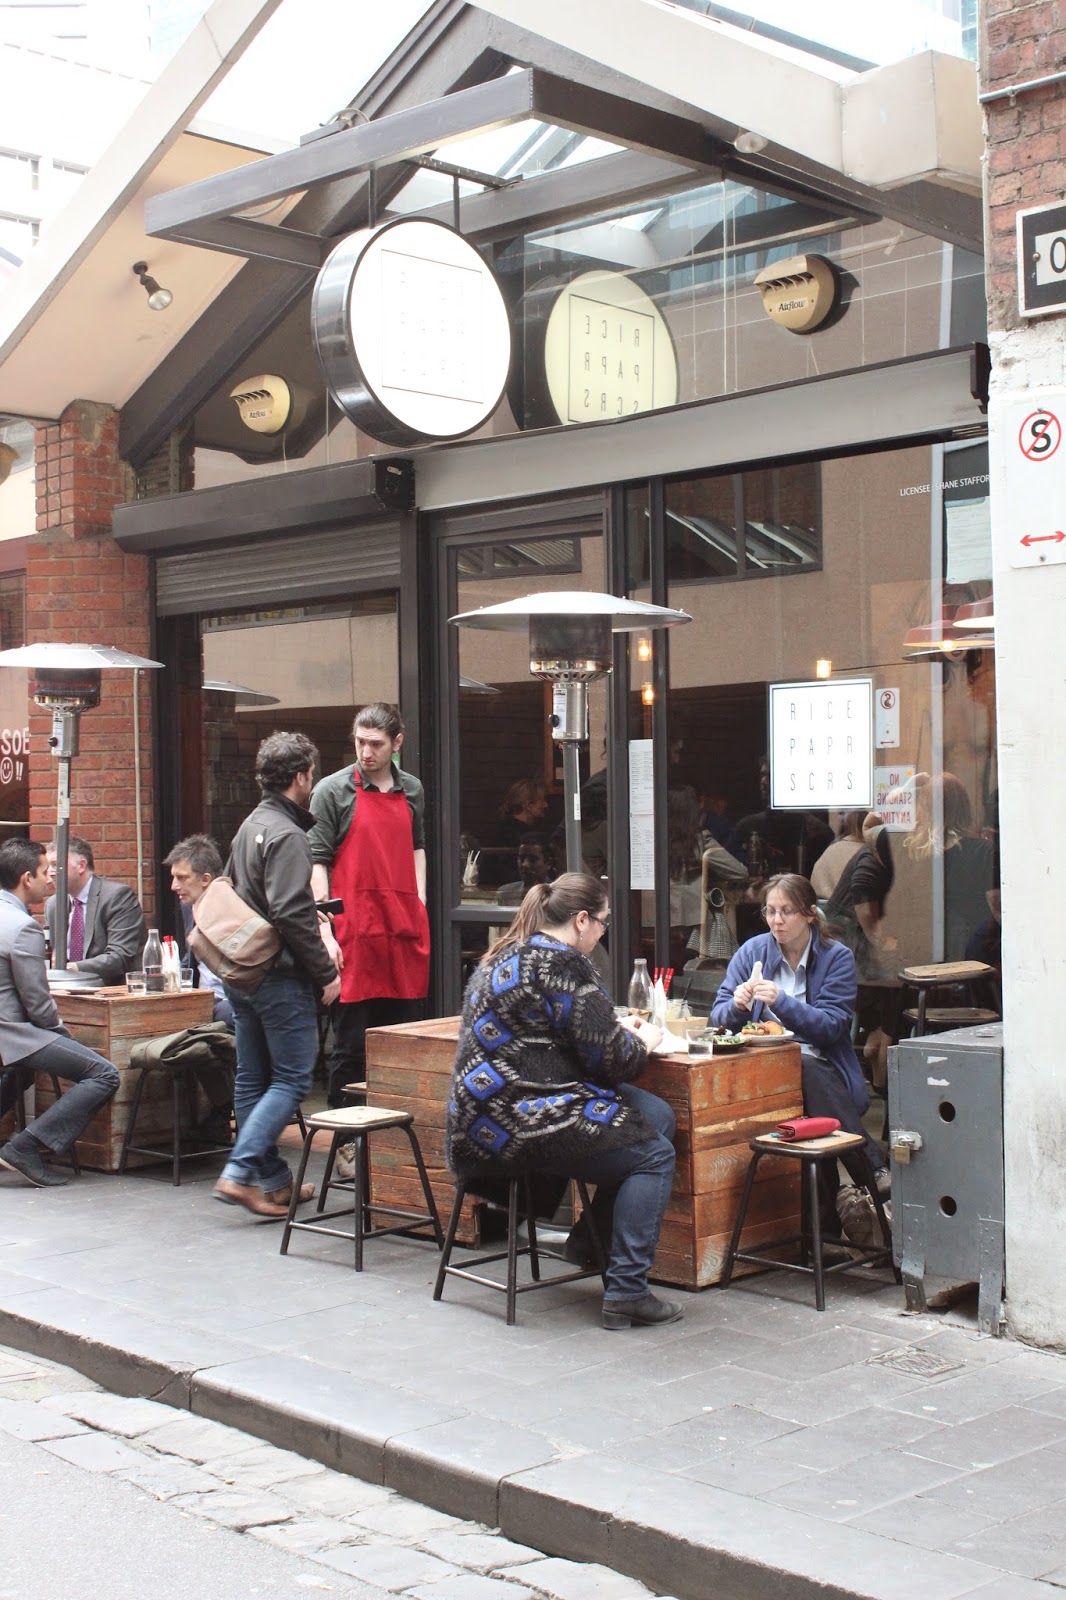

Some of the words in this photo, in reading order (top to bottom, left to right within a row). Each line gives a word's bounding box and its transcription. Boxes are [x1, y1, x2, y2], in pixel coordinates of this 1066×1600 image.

[778, 299, 806, 312] Airflow
[900, 485, 931, 496] LICENSEE
[935, 478, 959, 491] SHANE
[790, 699, 852, 721] RICE
[789, 735, 853, 756] PAPR
[790, 771, 853, 791] SCRS
